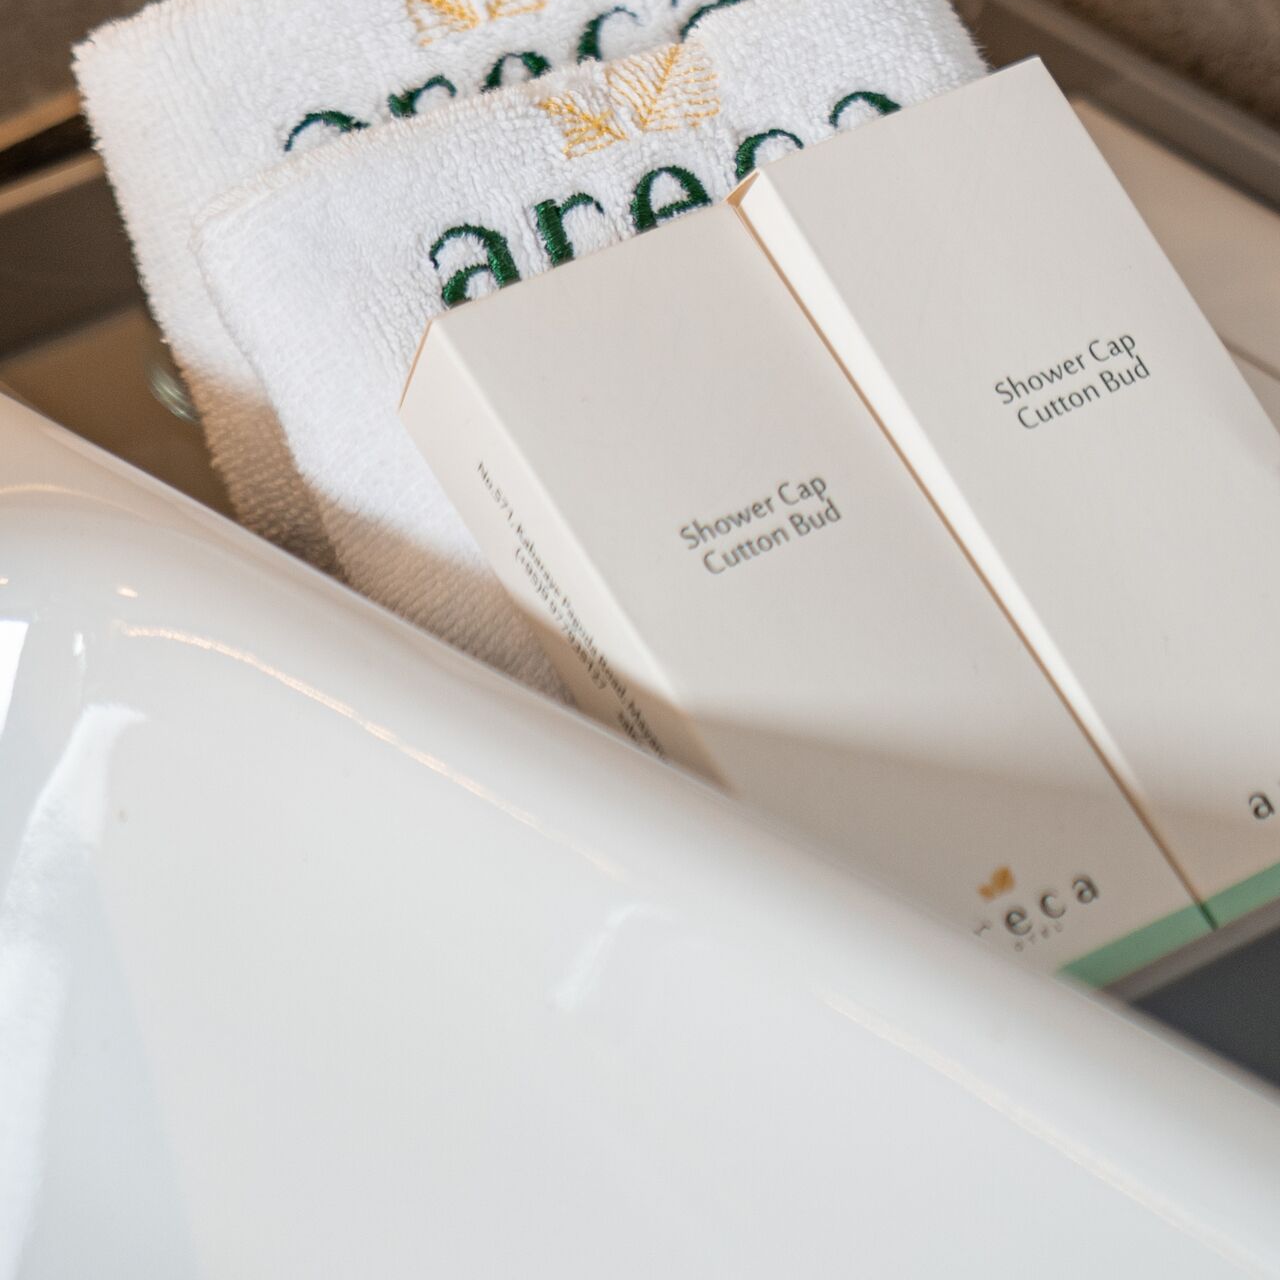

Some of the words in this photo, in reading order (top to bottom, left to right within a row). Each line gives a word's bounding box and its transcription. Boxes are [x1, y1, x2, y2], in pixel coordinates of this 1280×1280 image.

[429, 90, 901, 307] arec
[994, 353, 1087, 405] Shower
[1088, 333, 1137, 363] Cap
[1016, 383, 1101, 430] Cutton
[1099, 354, 1151, 394] Bud
[679, 496, 775, 550] Shower
[777, 476, 828, 506] Cap
[702, 525, 791, 575] Cutton
[788, 497, 842, 537] Bud
[973, 873, 1099, 938] reca
